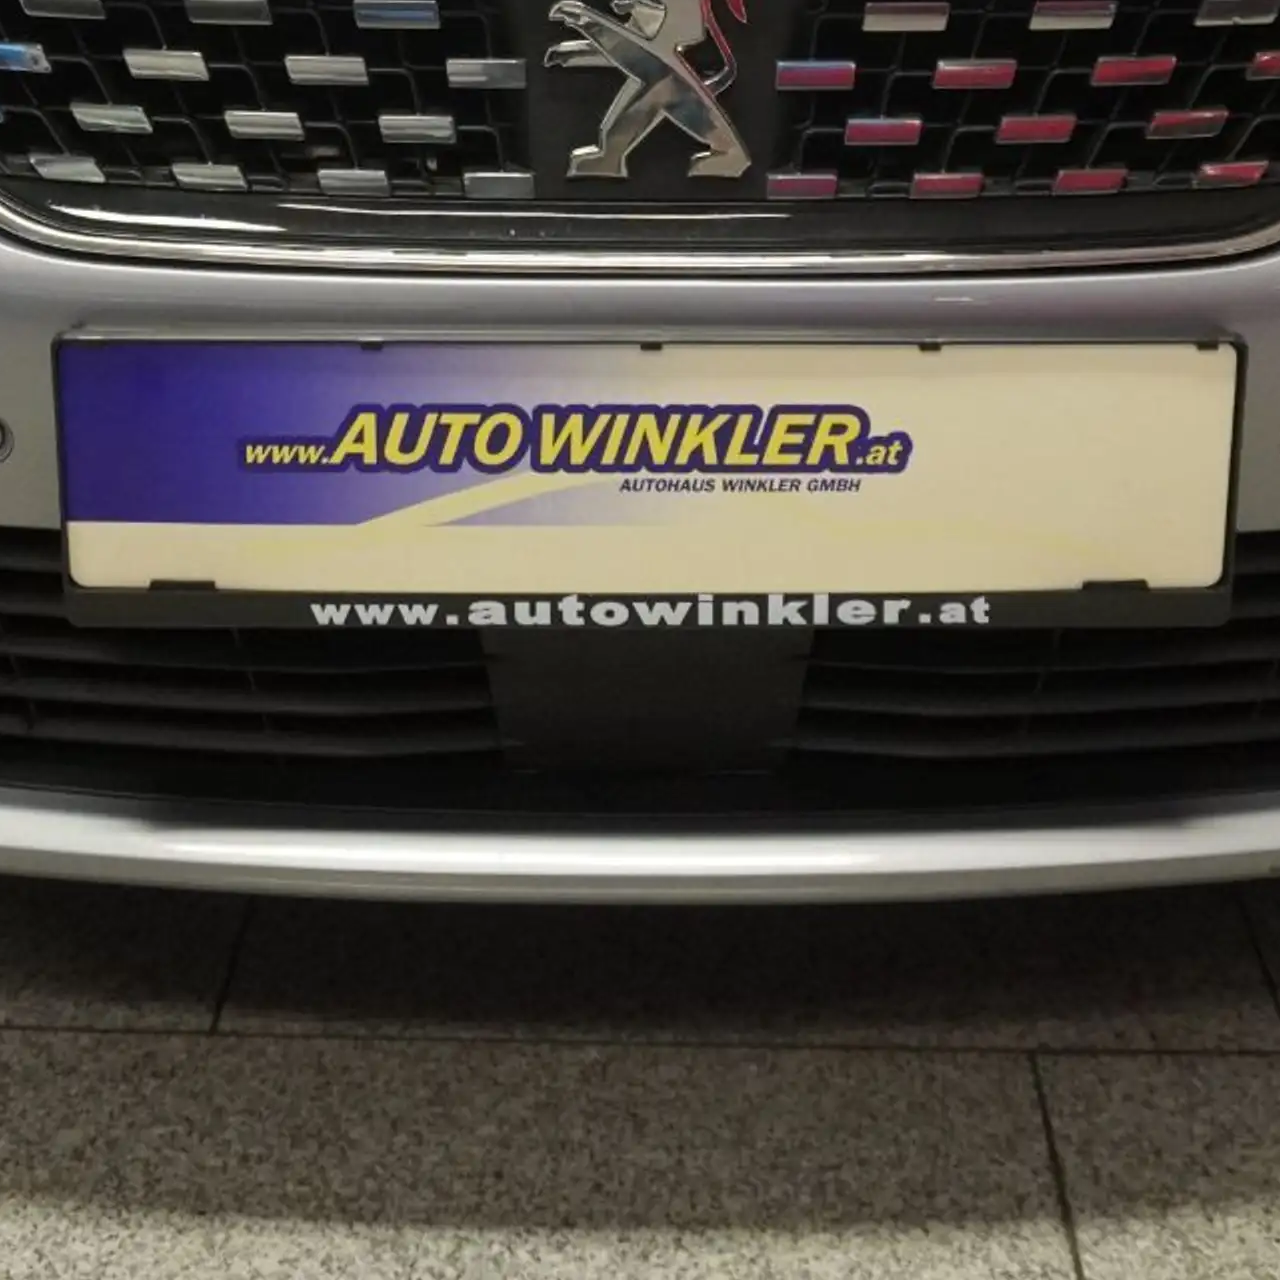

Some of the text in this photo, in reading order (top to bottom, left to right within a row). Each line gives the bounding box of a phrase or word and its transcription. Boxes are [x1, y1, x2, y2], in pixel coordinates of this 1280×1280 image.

[619, 478, 861, 493] AUTOHAUS WINKLER GMBH
[309, 592, 991, 626] www.autowinkler.at
